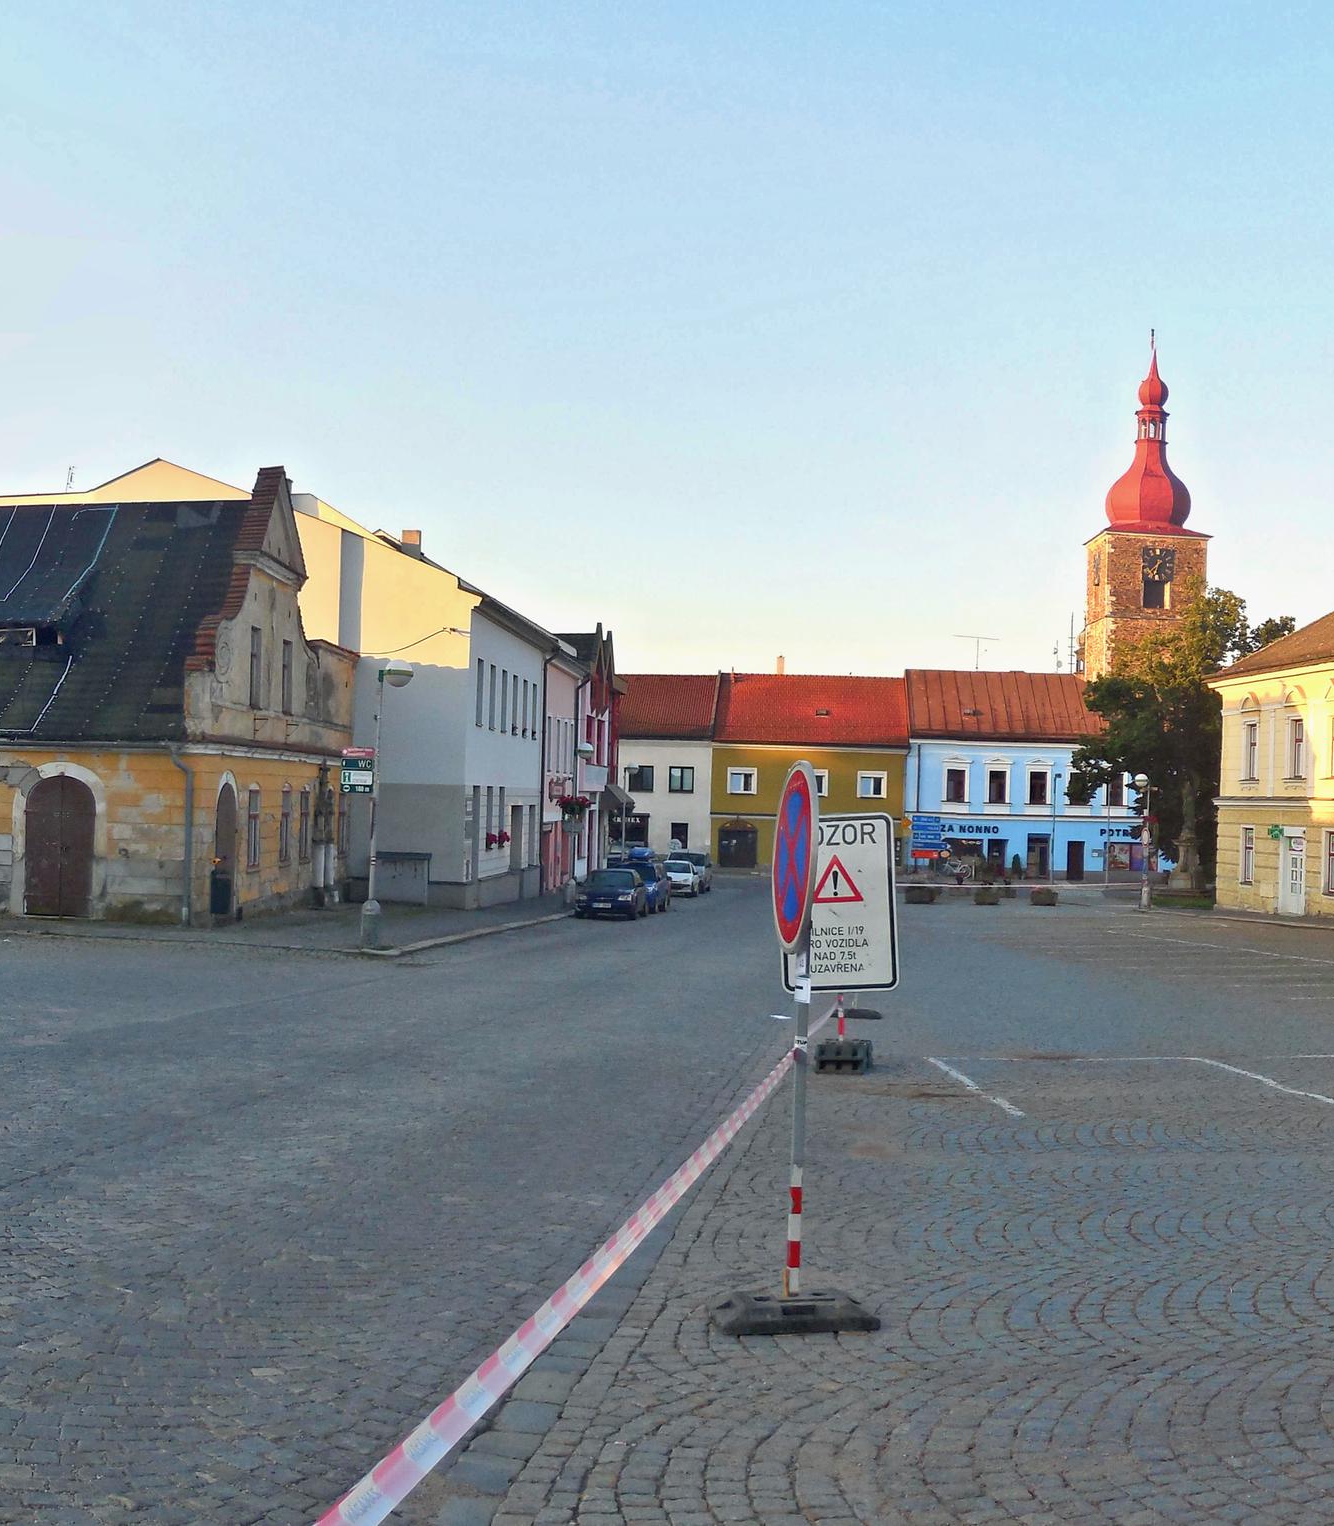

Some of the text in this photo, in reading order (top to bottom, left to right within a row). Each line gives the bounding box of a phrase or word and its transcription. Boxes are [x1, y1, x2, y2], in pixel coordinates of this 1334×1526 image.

[358, 760, 372, 769] WC
[819, 822, 877, 846] ZOR
[959, 825, 1000, 834] NONNO
[811, 926, 844, 937] ILNICE
[810, 938, 869, 949] RO VOZIDLA
[814, 951, 837, 961] NAD
[810, 961, 866, 974] UZAVŘENA
